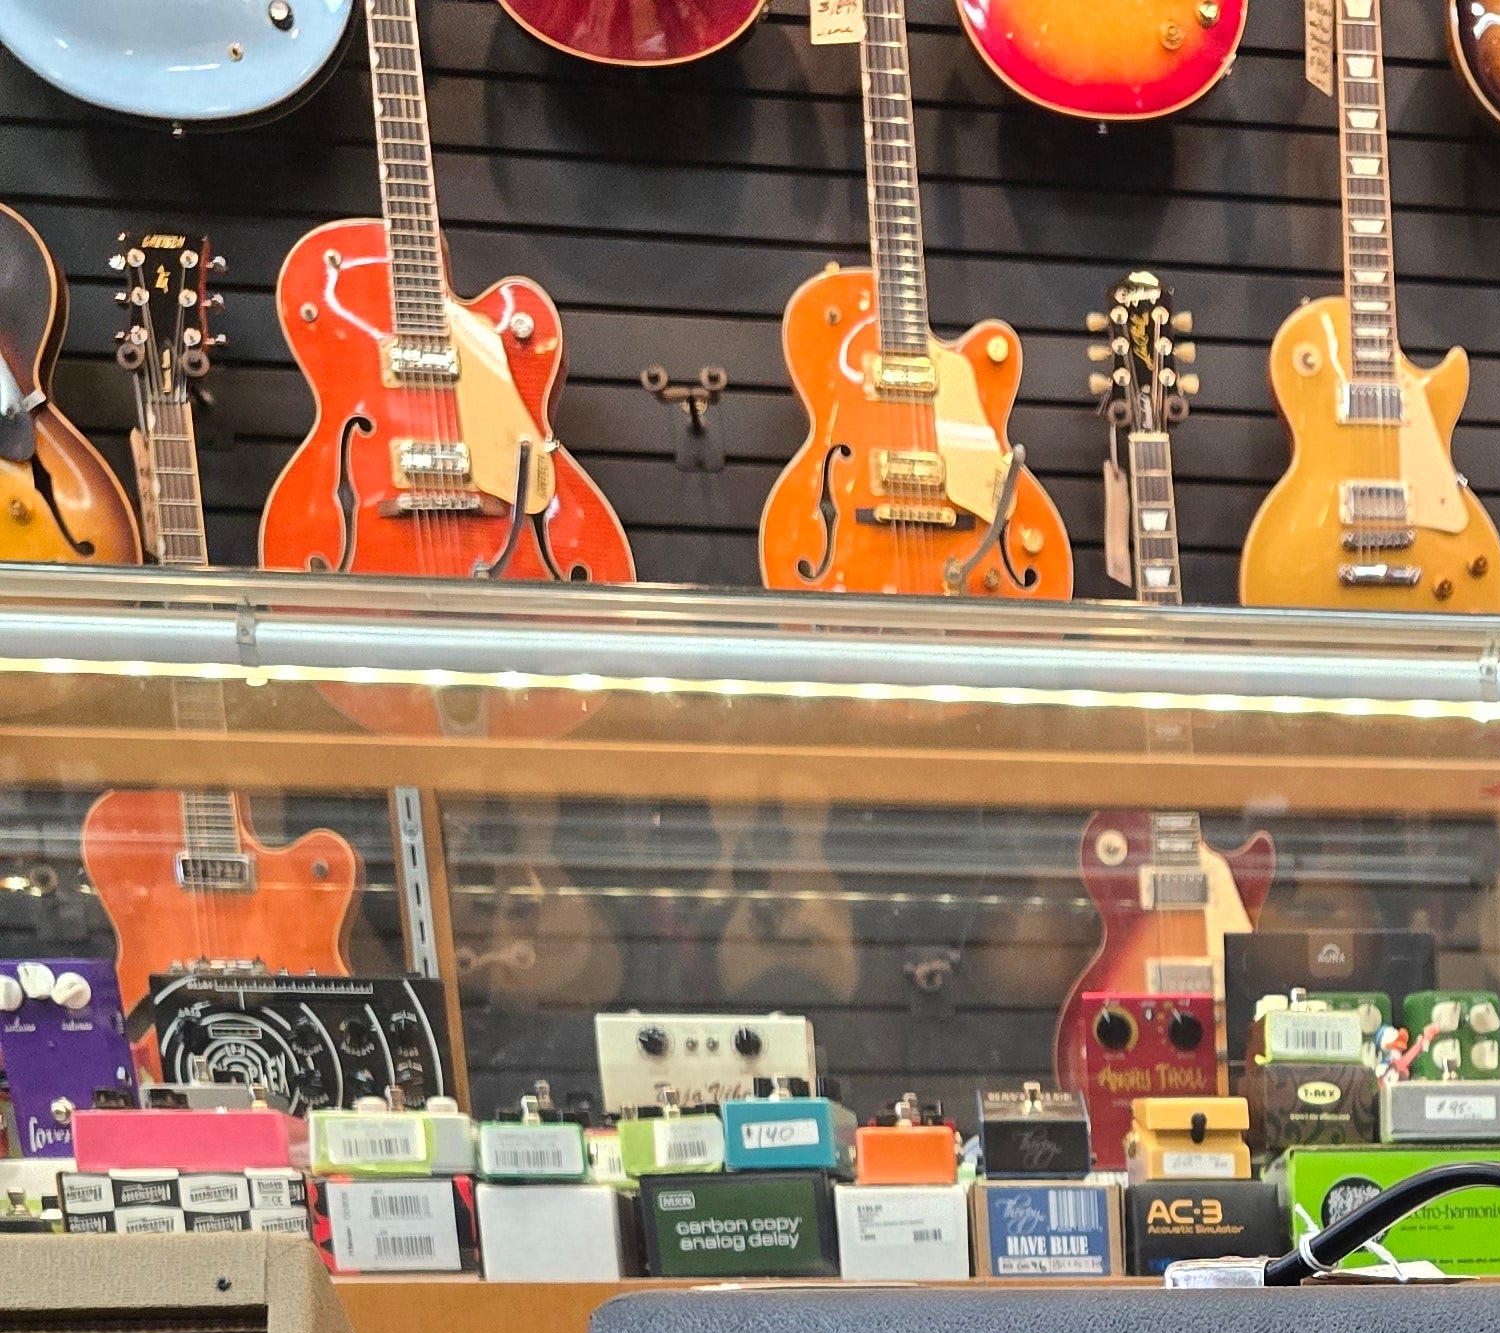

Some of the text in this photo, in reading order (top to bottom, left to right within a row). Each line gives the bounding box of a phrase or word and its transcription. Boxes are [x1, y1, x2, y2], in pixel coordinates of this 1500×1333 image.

[676, 1217, 801, 1235] carbon copy
[680, 1232, 799, 1252] analog delay
[1007, 1235, 1089, 1256] HAVE BLUE
